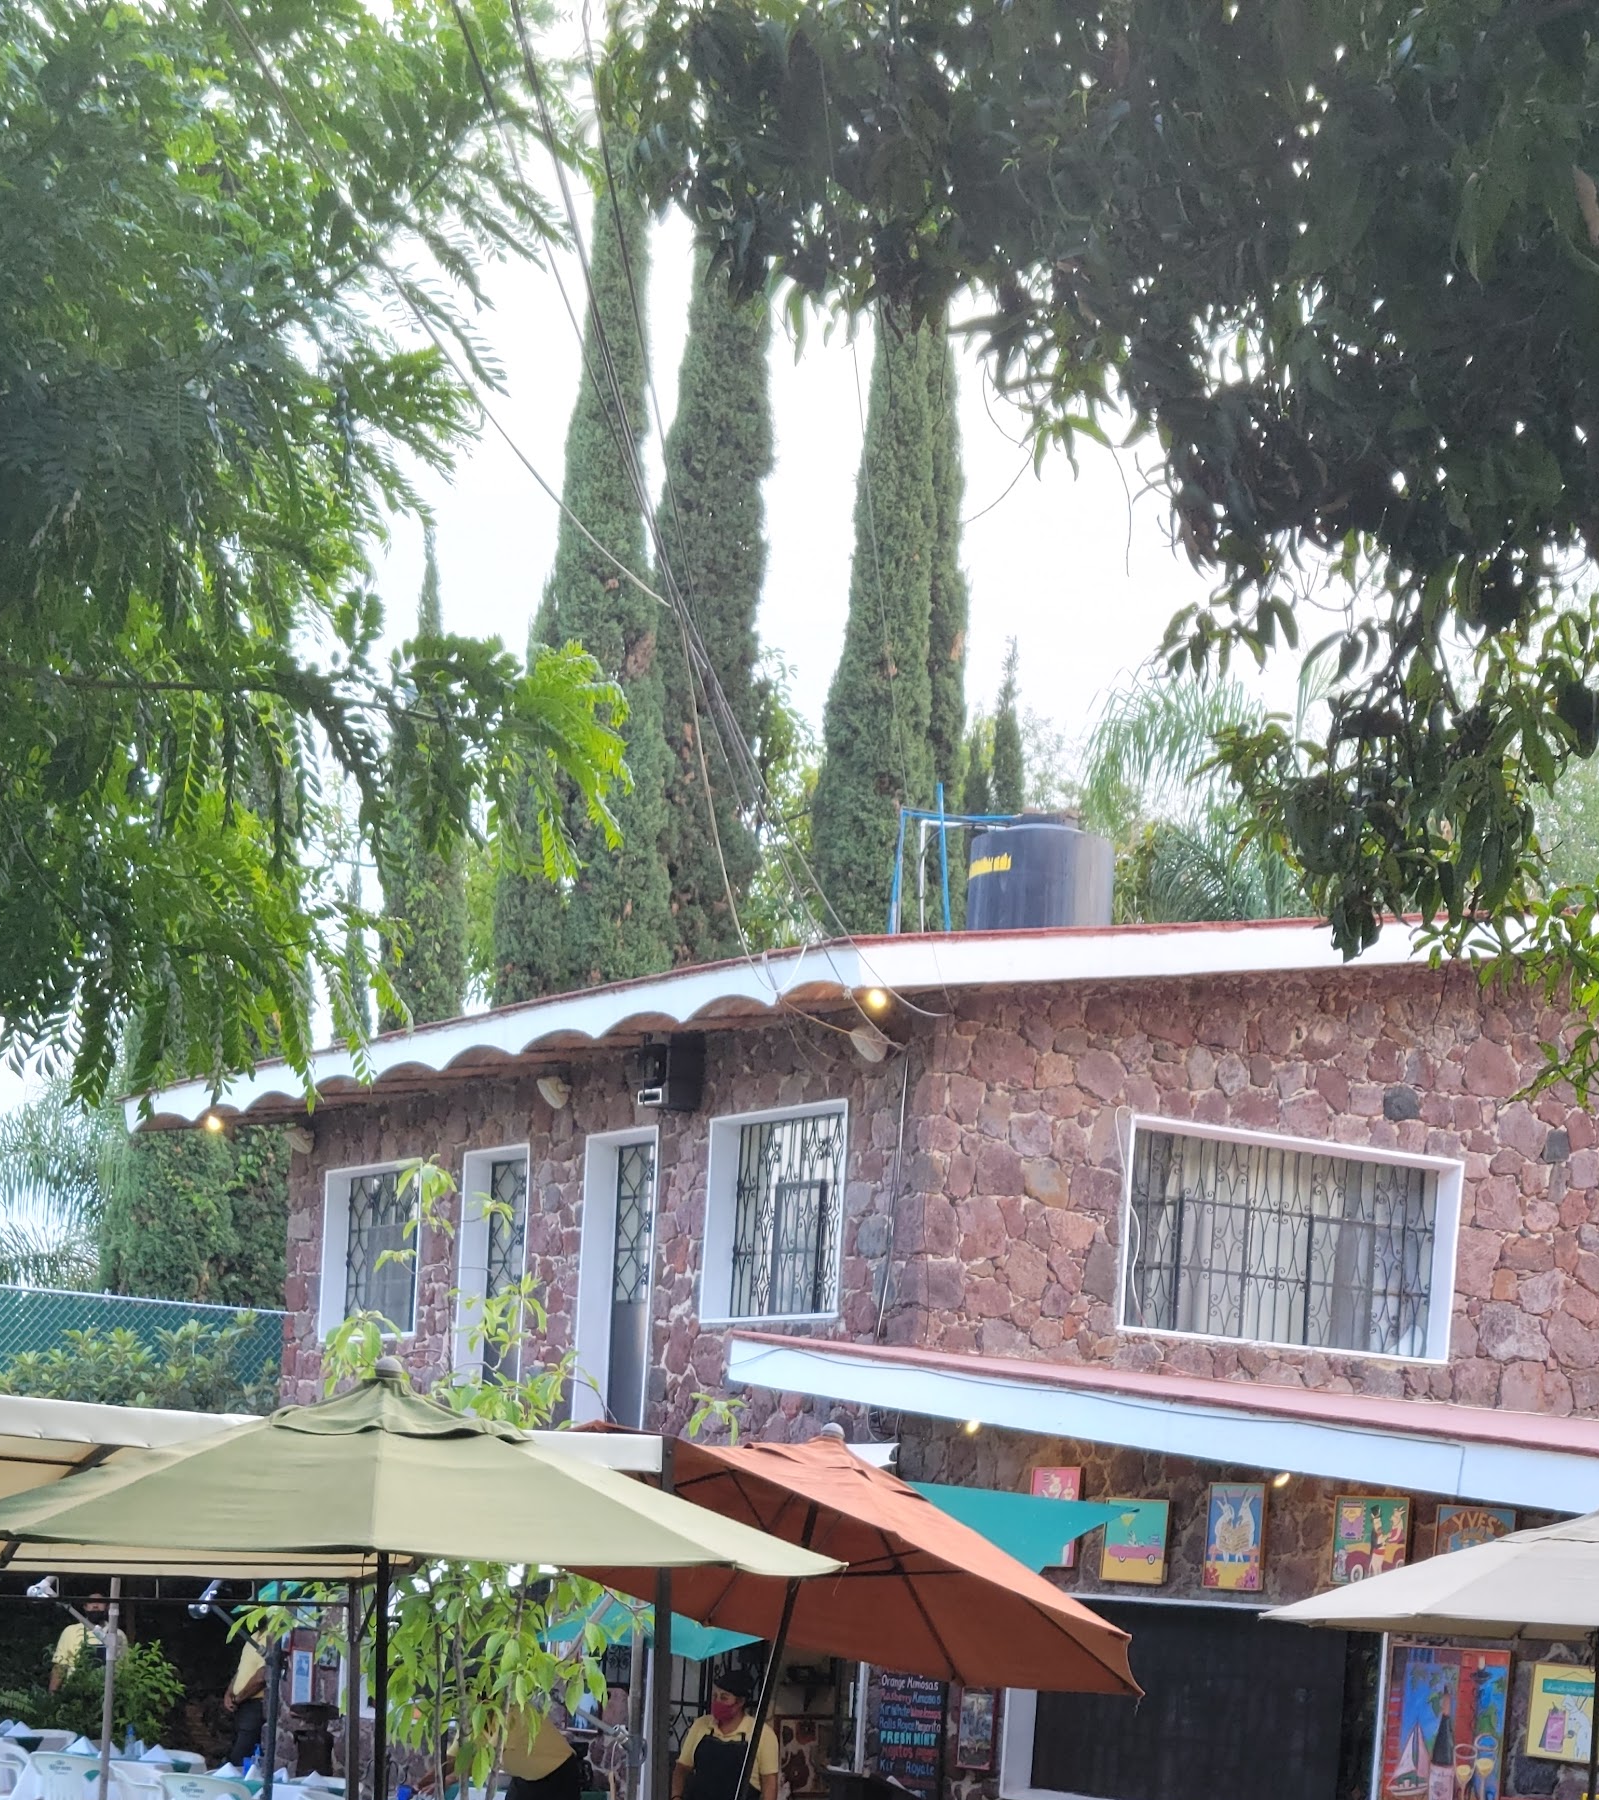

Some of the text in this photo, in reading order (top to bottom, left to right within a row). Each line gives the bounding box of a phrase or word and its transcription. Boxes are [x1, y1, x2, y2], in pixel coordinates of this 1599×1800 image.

[881, 1674, 939, 1691] Orange Mimosas
[880, 1731, 912, 1745] FRESH
